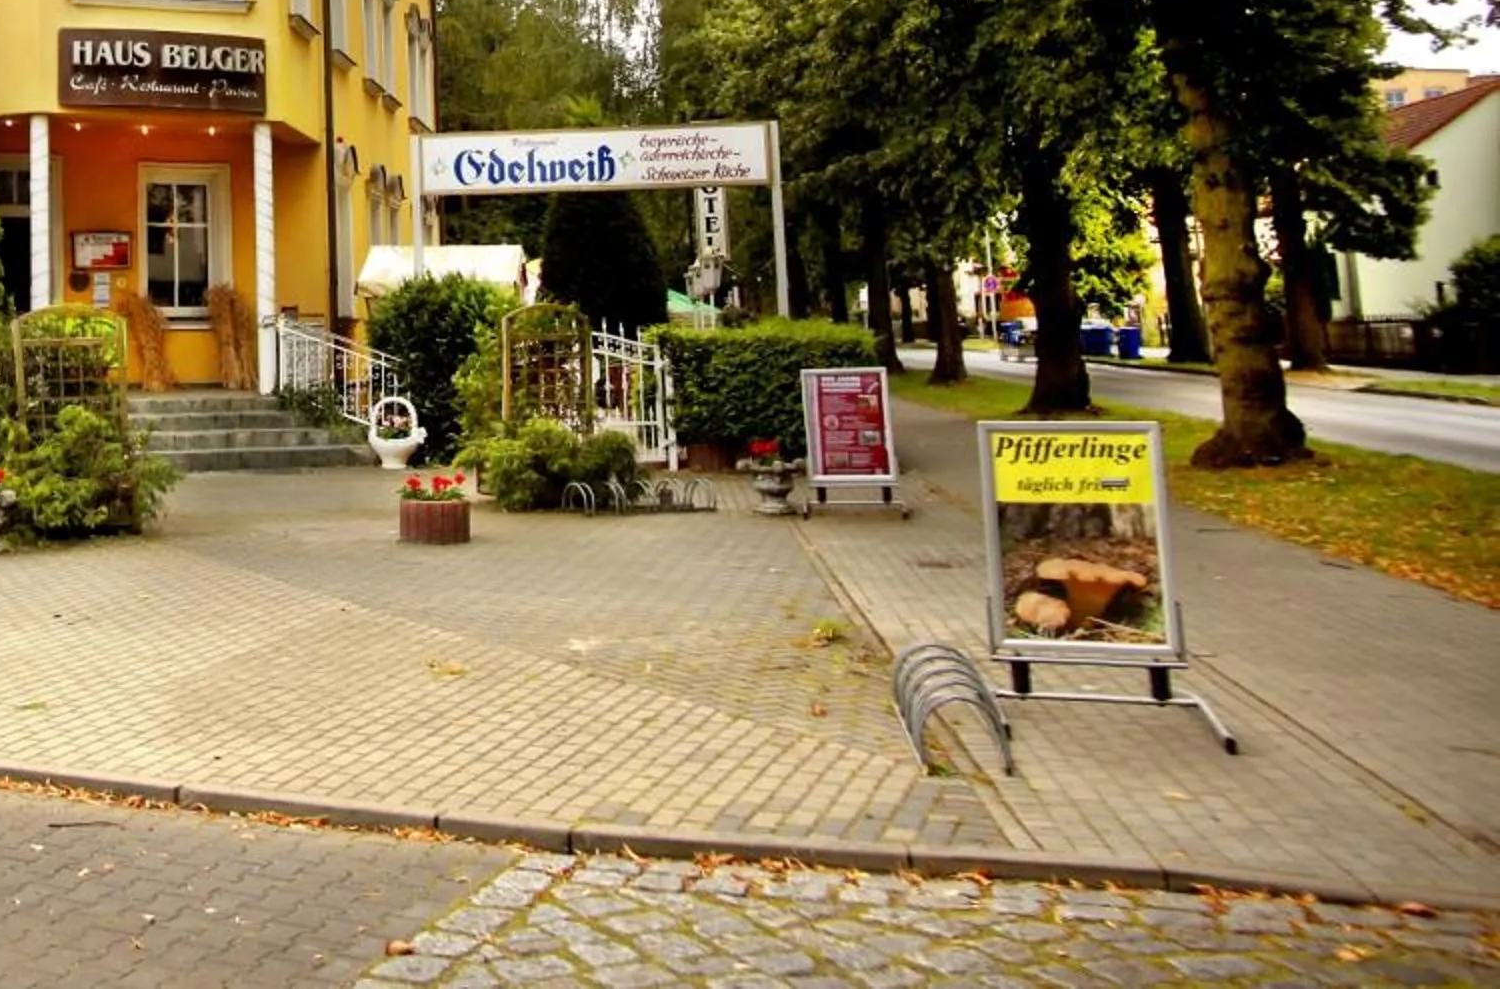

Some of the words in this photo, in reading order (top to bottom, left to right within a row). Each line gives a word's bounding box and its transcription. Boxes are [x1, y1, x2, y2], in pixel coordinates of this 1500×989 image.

[73, 40, 152, 67] HAUS
[161, 44, 265, 73] BELGER
[453, 144, 617, 187] Edelweiß
[995, 436, 1148, 465] Pfifferlinge
[1017, 477, 1073, 494] täglich
